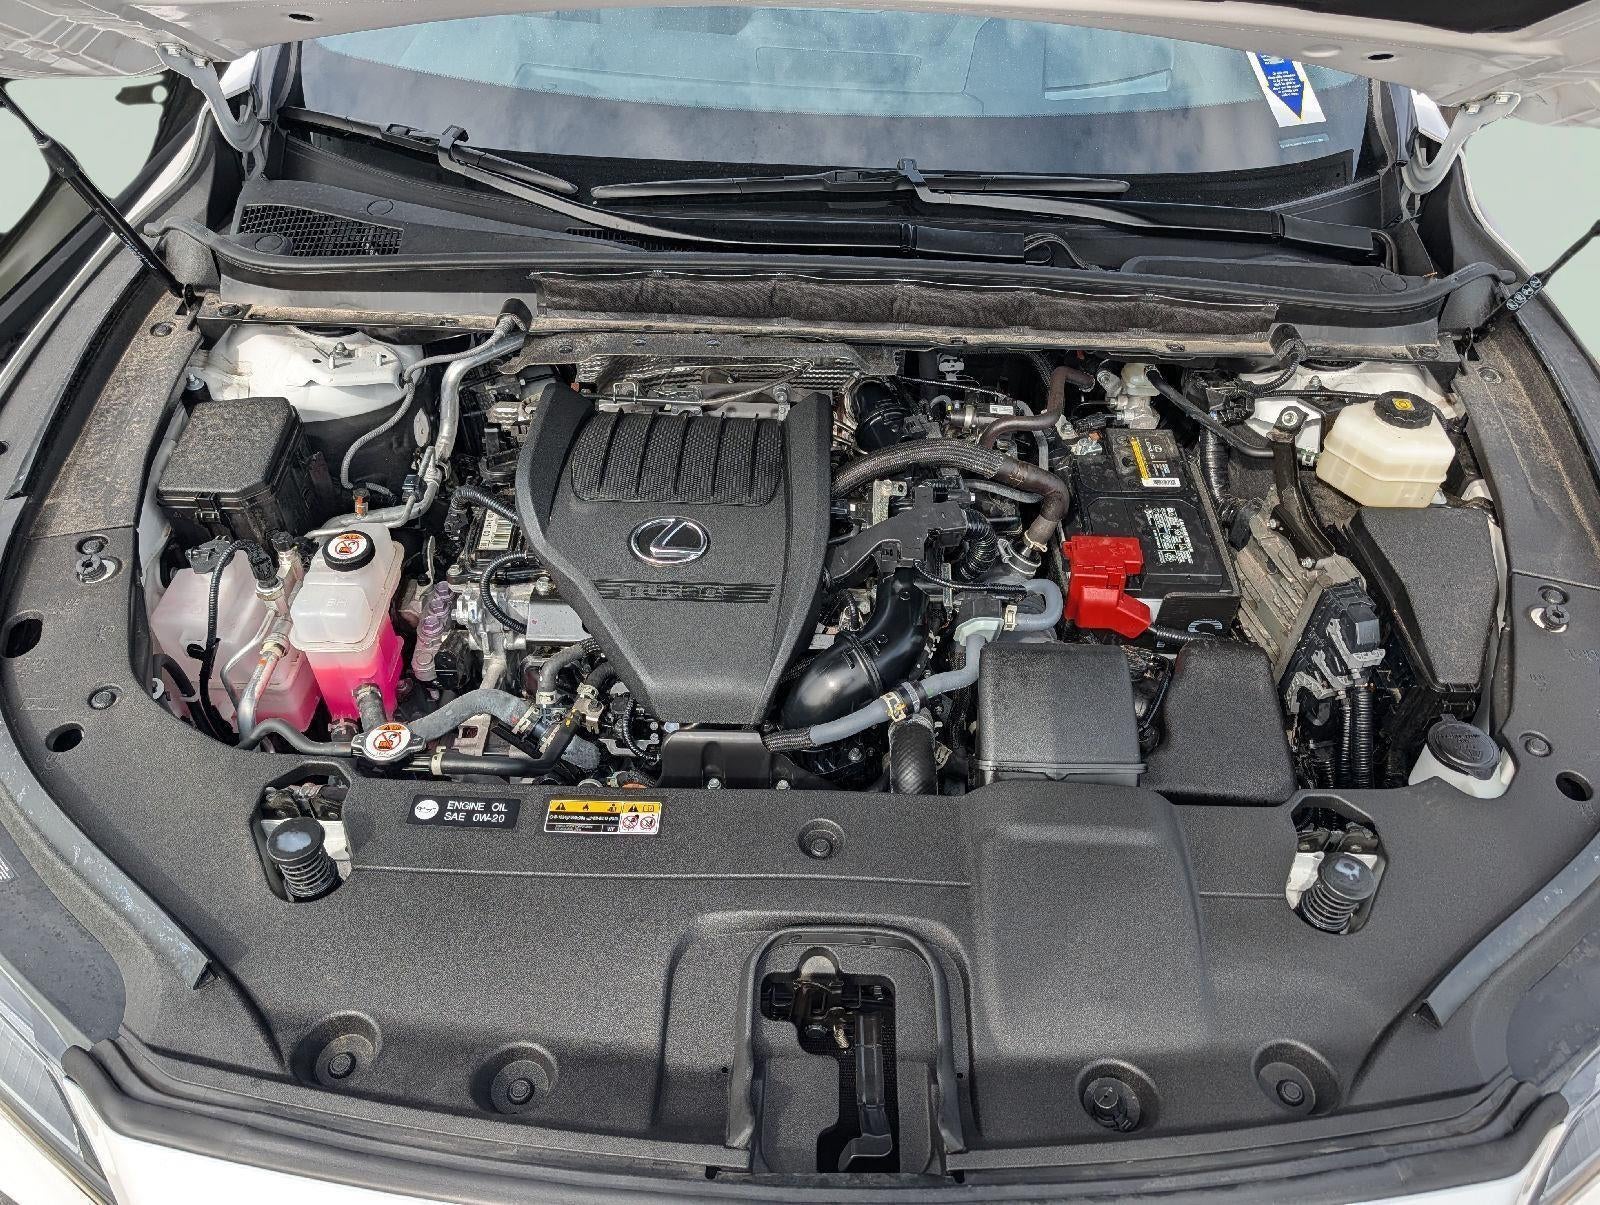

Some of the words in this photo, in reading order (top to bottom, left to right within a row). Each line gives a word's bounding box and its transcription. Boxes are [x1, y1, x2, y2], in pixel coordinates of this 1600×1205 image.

[447, 800, 485, 810] ENGINE
[491, 803, 508, 811] OIL
[444, 812, 466, 821] SAE
